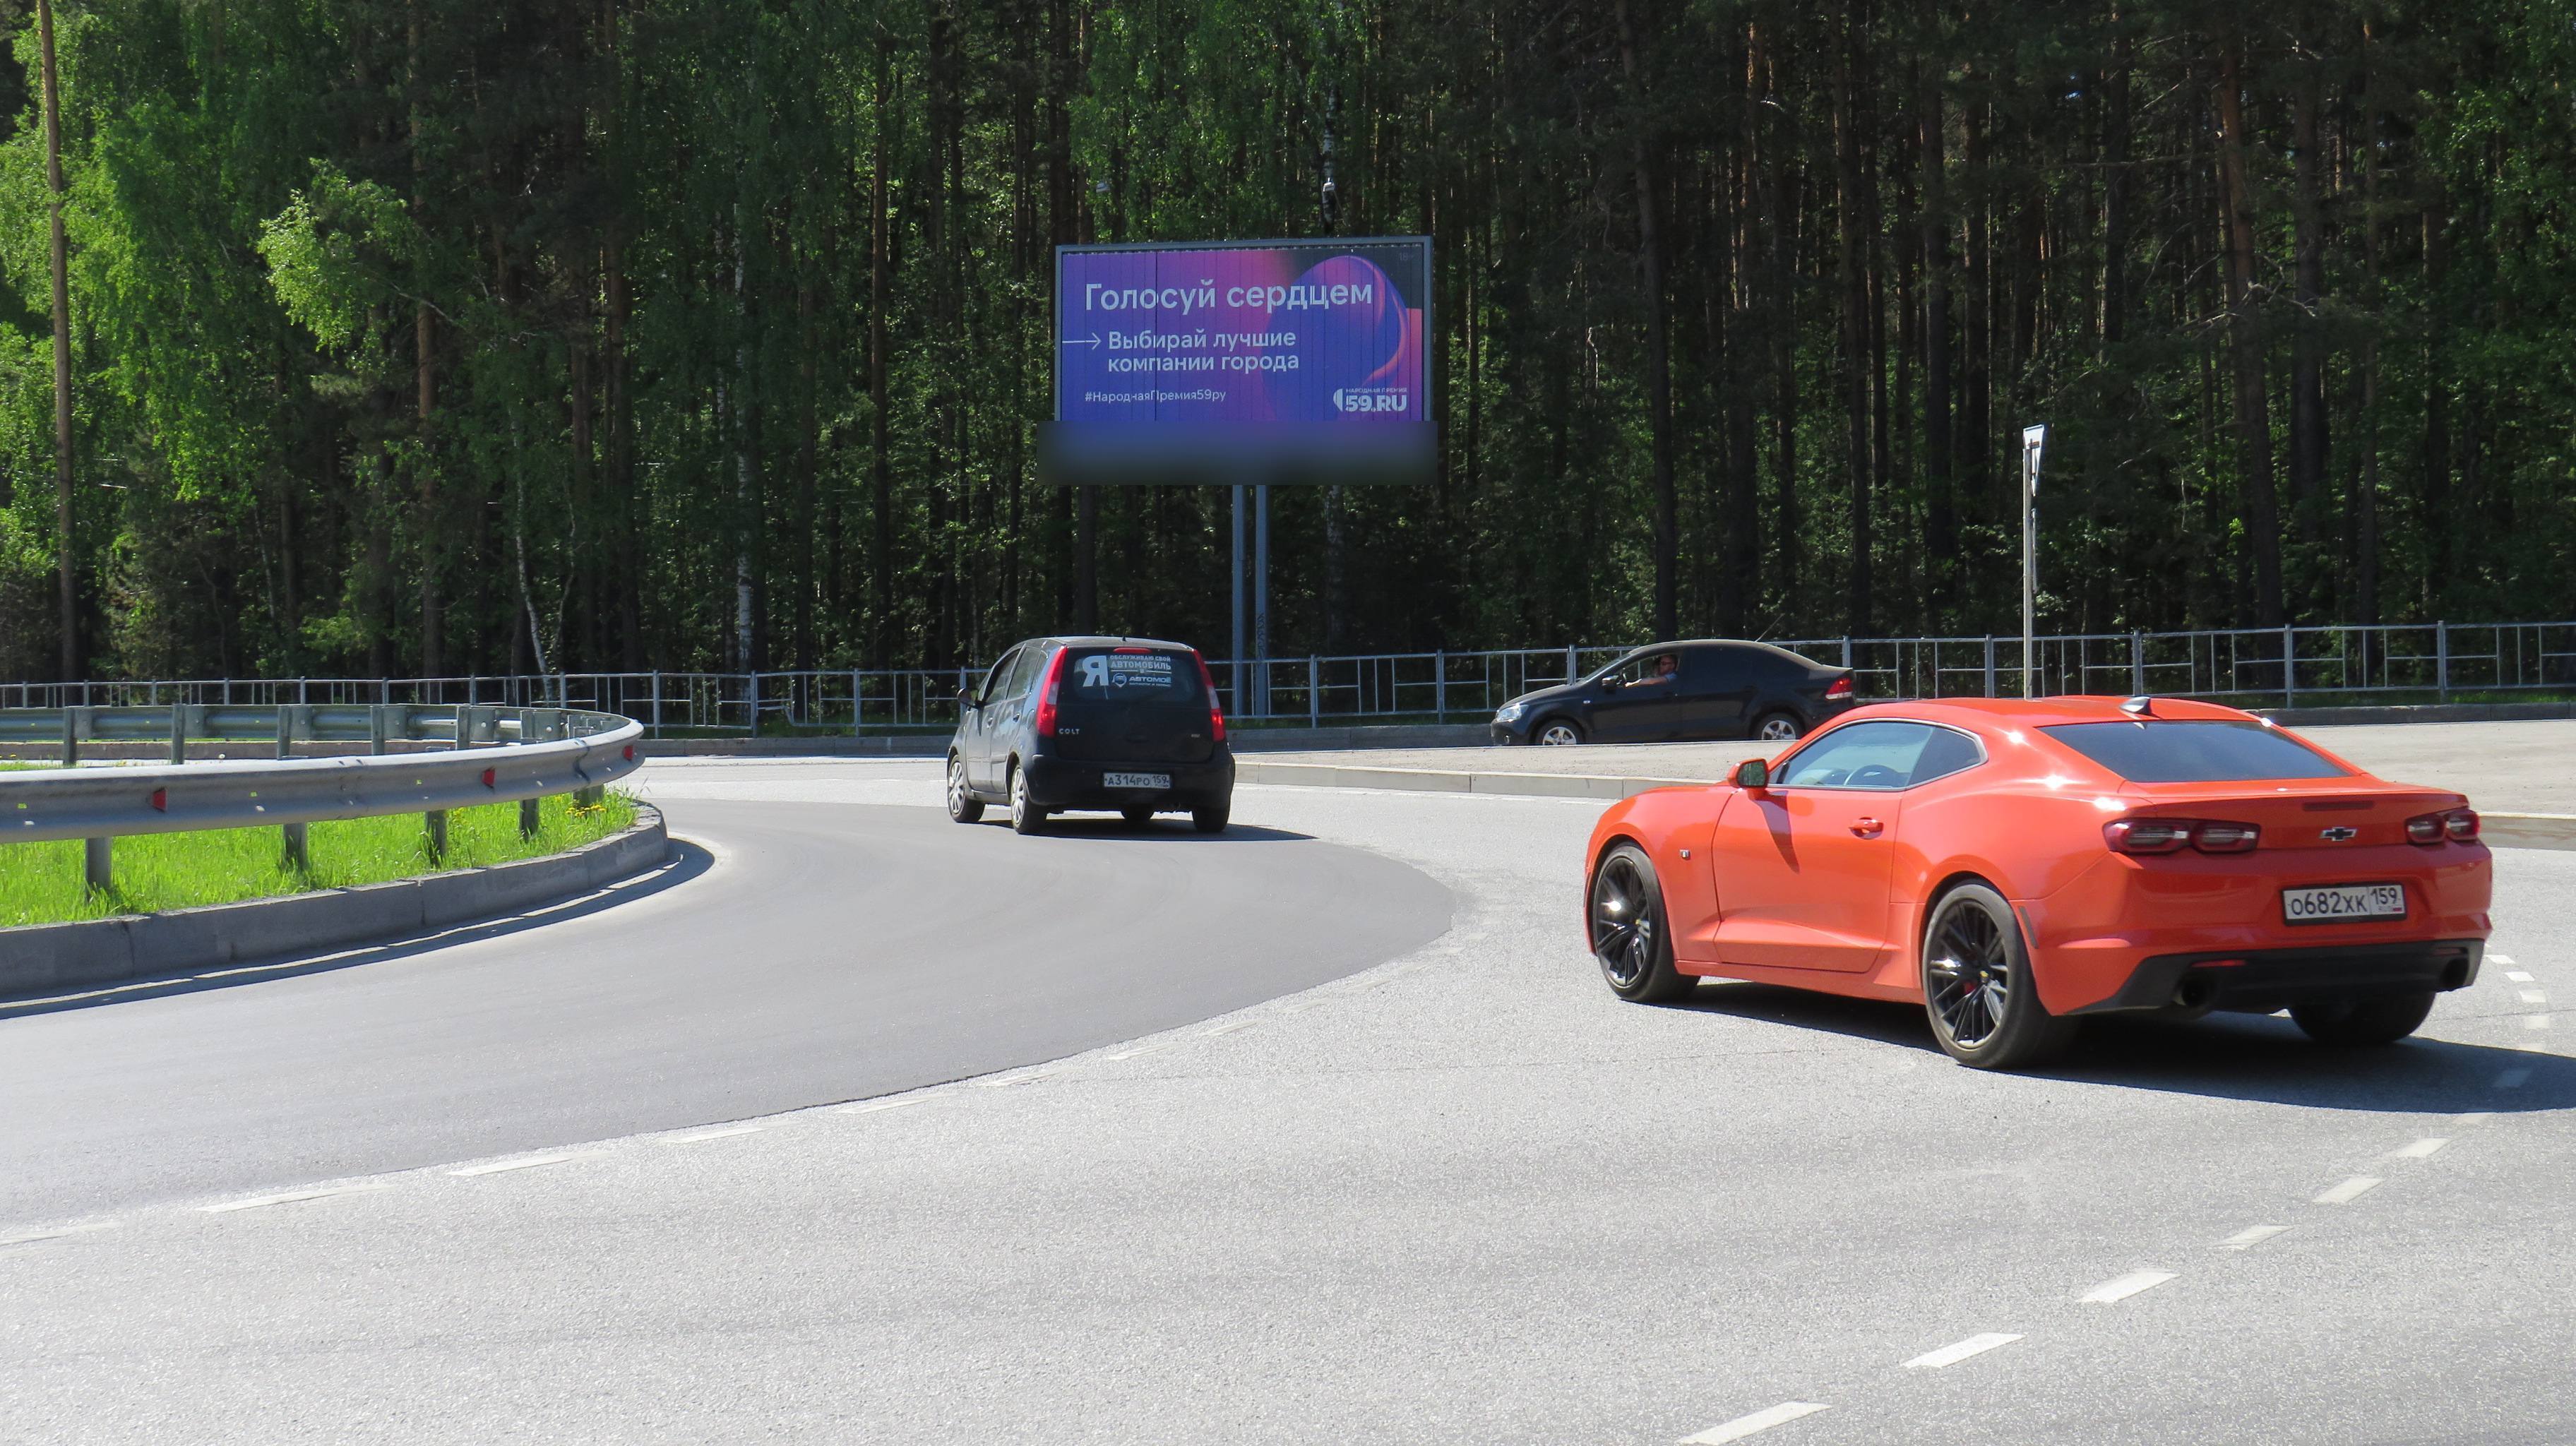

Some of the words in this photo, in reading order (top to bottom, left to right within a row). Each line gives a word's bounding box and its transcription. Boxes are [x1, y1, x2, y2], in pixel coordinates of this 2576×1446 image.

[1085, 279, 1216, 316] Голосуй
[1227, 284, 1372, 313] сердцем
[1109, 328, 1207, 353] Выбирай
[1212, 332, 1296, 352] лучшие
[1108, 357, 1215, 373] компании
[1222, 354, 1300, 375] города
[1085, 389, 1227, 405] #НароднаяПремия59ру
[1345, 395, 1407, 412] 59.RU
[1083, 655, 1109, 688] Я
[1111, 661, 1171, 670] АВТОМОБИЛЬ
[2370, 887, 2397, 905] 159
